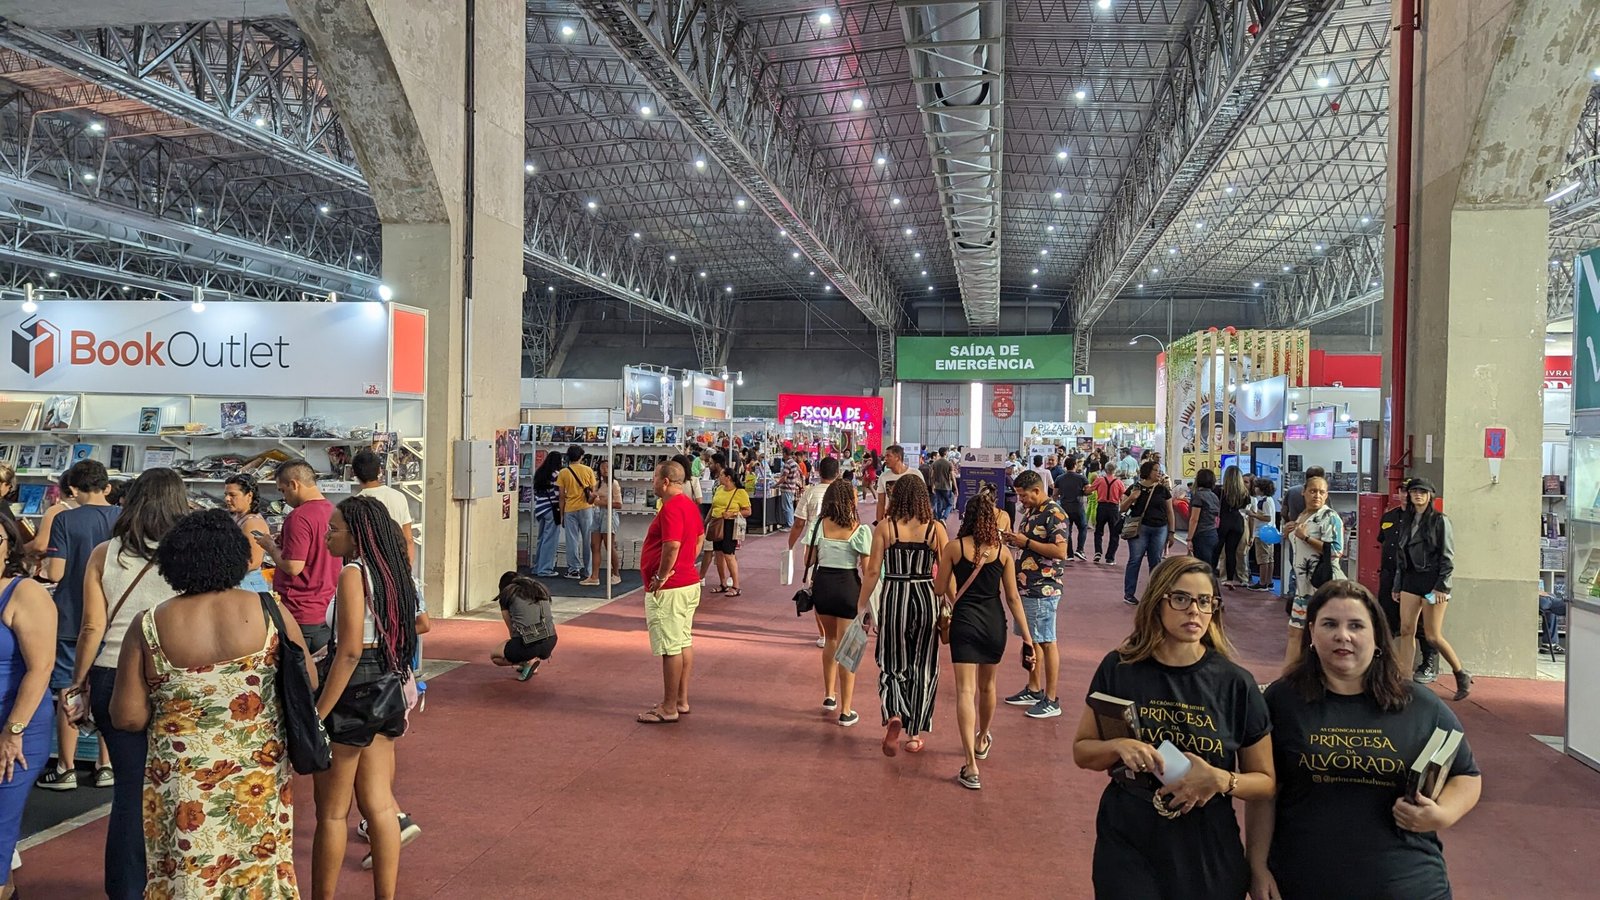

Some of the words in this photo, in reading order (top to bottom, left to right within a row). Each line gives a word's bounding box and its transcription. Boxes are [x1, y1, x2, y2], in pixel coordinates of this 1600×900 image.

[71, 330, 290, 368] BookOutlet
[950, 343, 995, 356] SAÍDA
[1000, 345, 1019, 356] DE
[935, 357, 1035, 370] EMERGÊNCIA
[1078, 378, 1090, 393] H
[800, 406, 842, 419] ESCOLA
[846, 407, 861, 419] DE
[1140, 707, 1217, 732] PRINCESA
[1310, 734, 1398, 753] PRINCESA
[1299, 751, 1407, 777] ALVORADA
